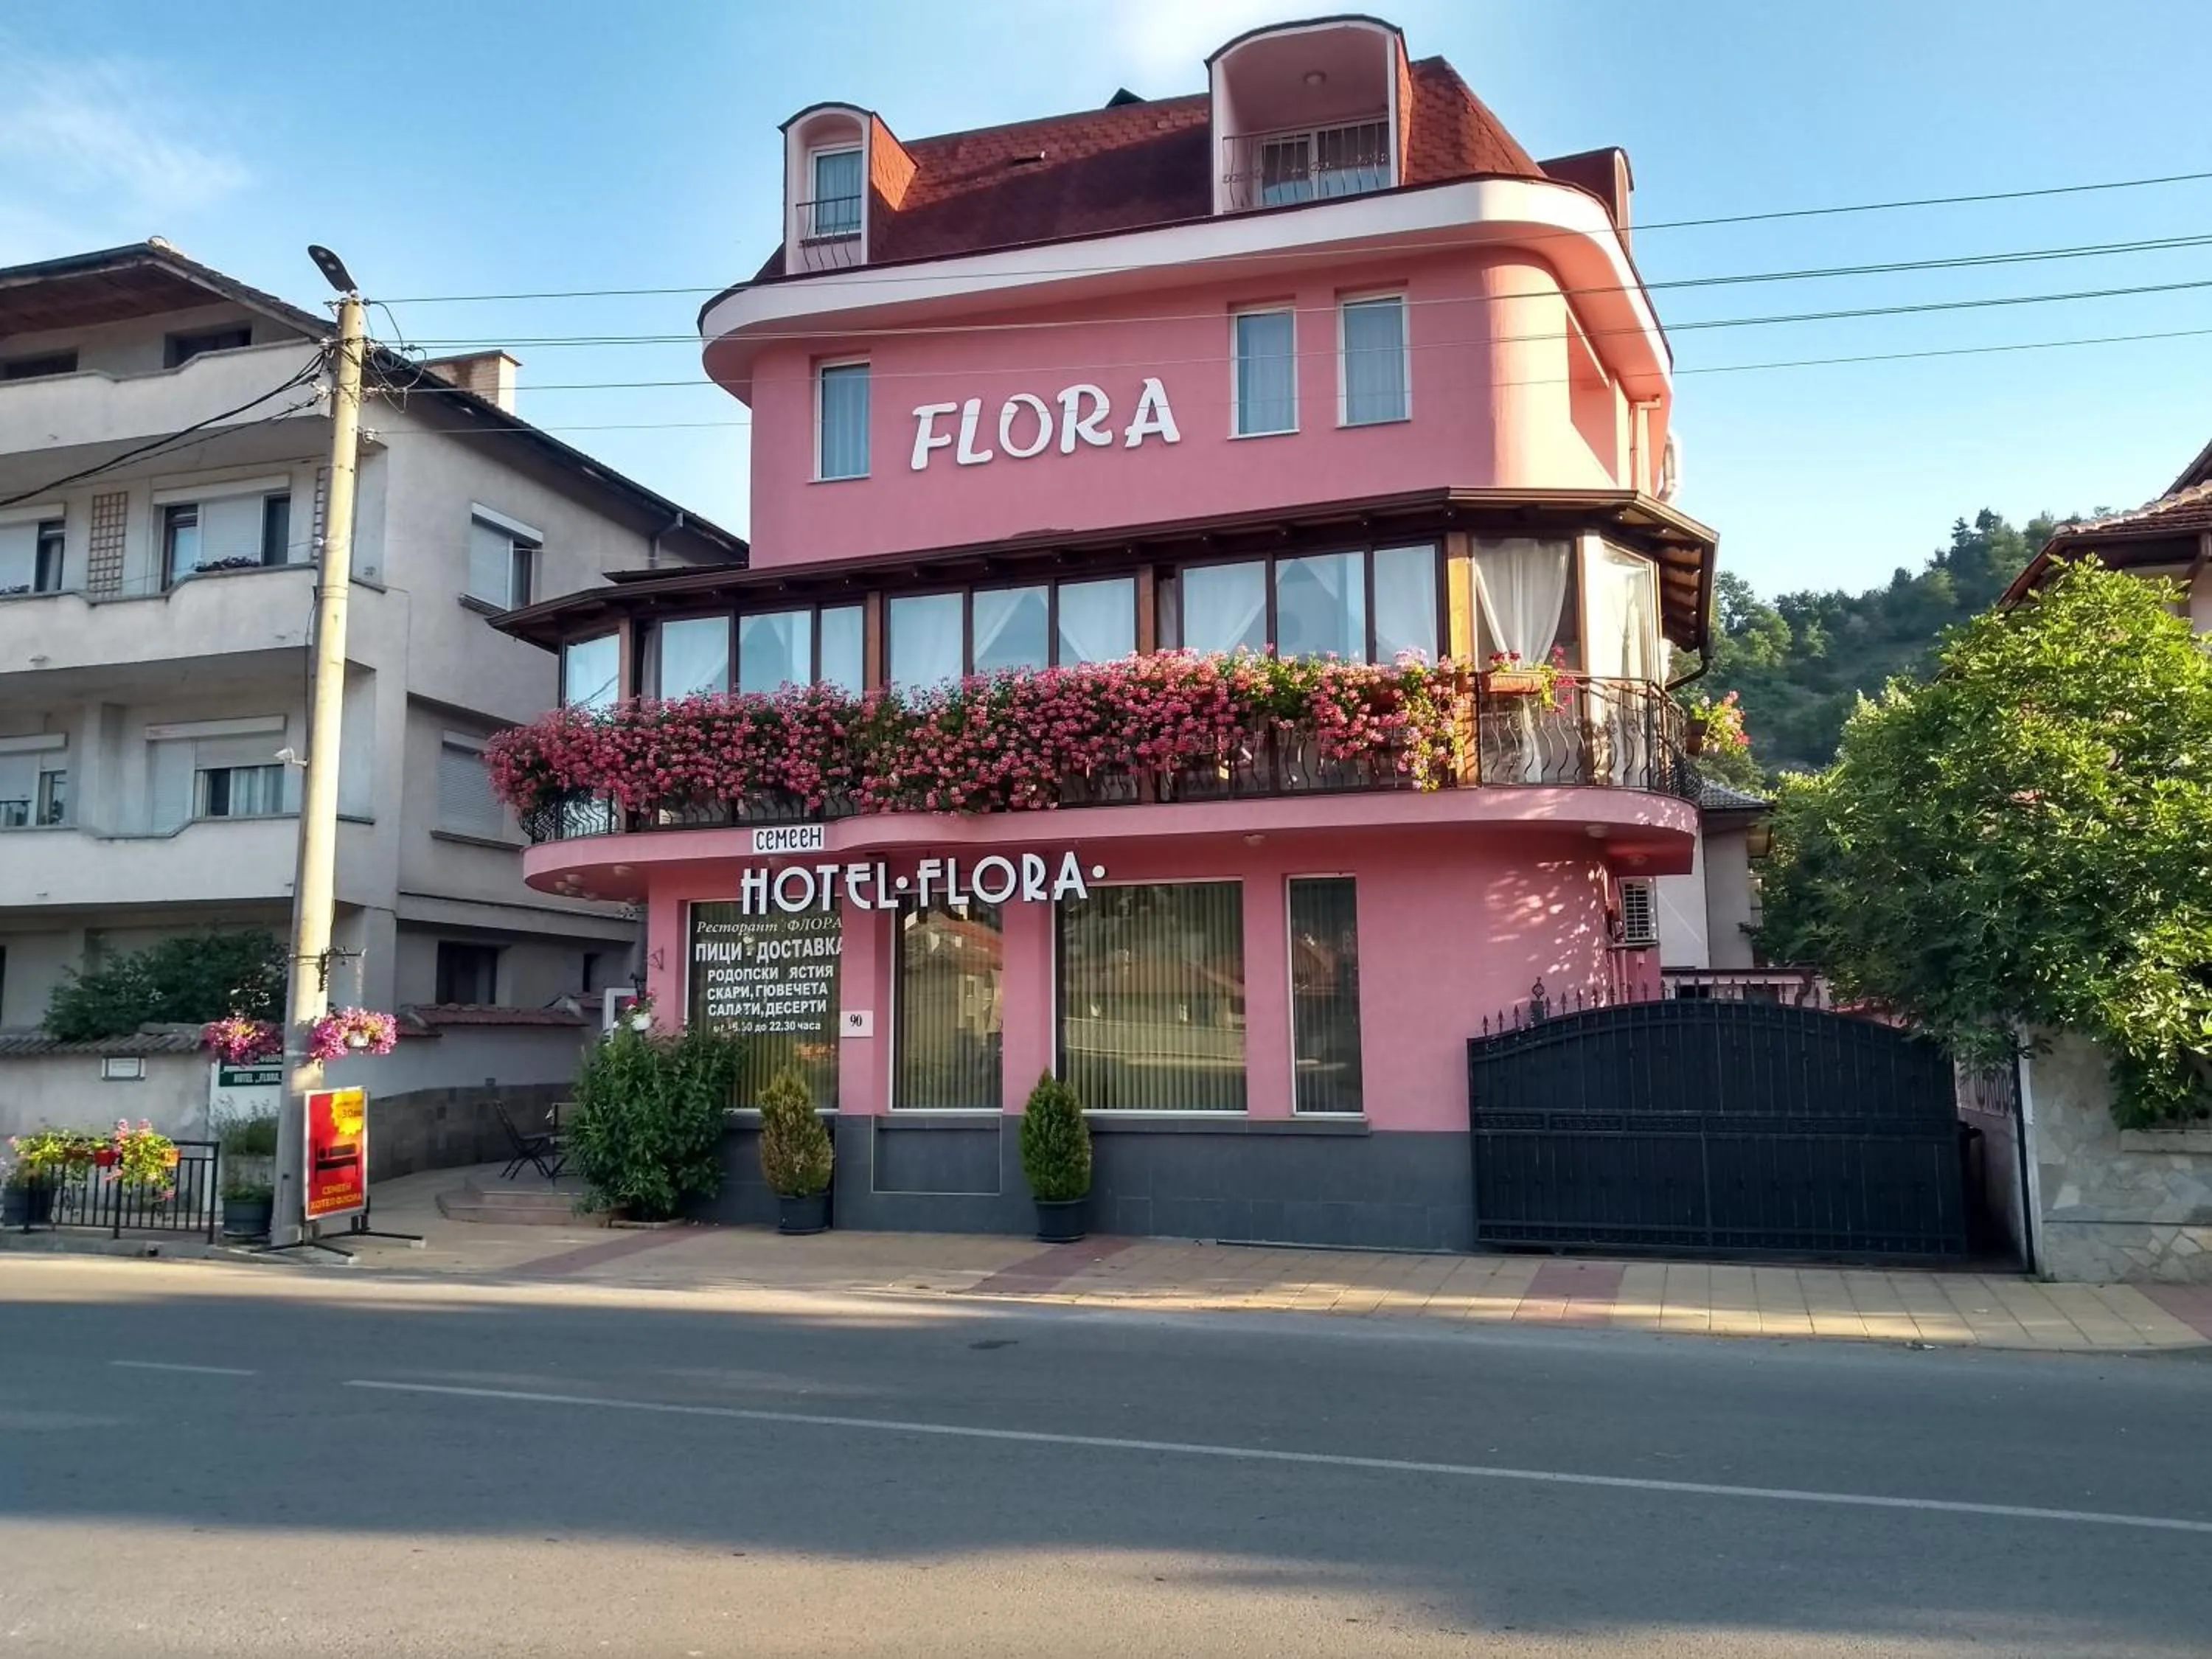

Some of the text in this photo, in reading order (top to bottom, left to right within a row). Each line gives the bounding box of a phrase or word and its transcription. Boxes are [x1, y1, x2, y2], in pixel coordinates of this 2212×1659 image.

[911, 378, 1180, 470] FLORA
[740, 852, 1088, 915] HOTEL FLORA
[695, 921, 778, 936] Ресторант
[695, 942, 742, 964] ПИЦИ
[708, 965, 834, 984] РОДОПСКИ ЯСТИЯ
[754, 1023, 768, 1034] до
[769, 1020, 796, 1032] 22.30
[797, 1021, 821, 1031] часа
[849, 1014, 863, 1027] 90
